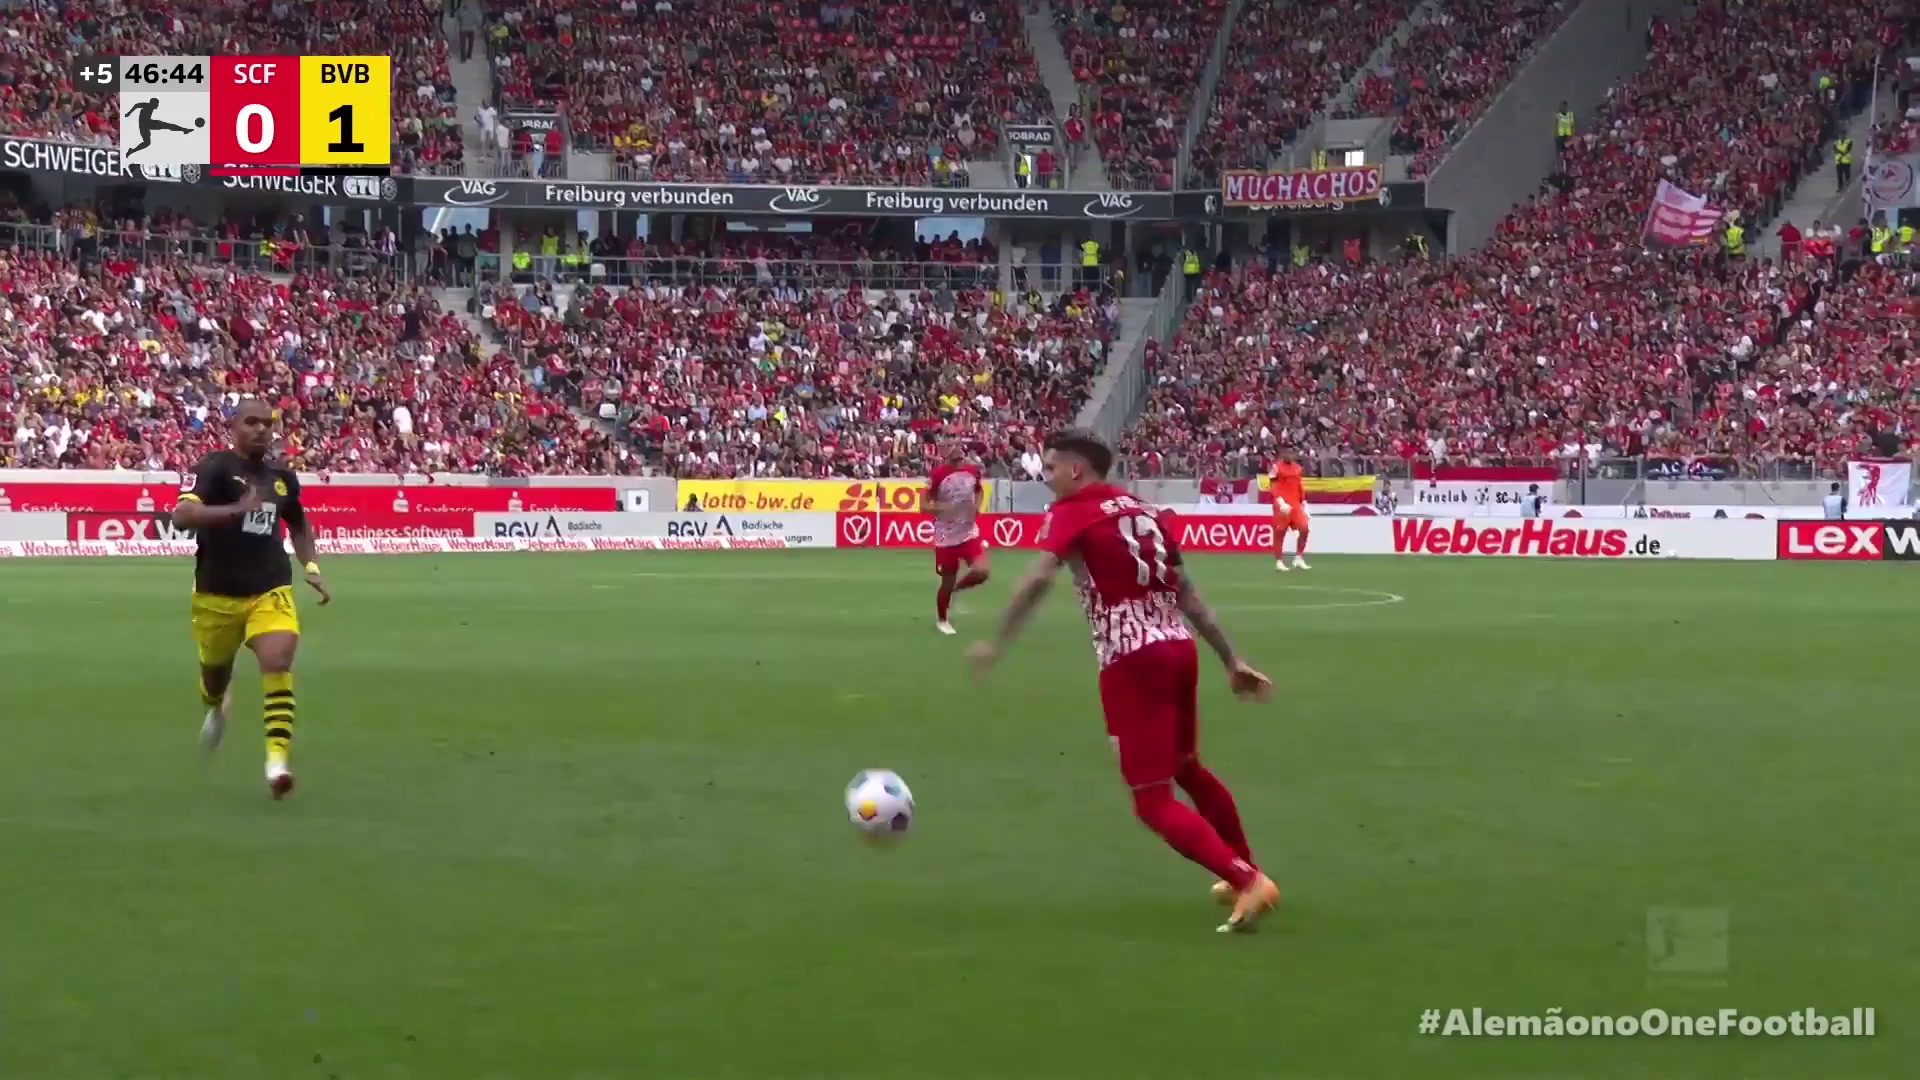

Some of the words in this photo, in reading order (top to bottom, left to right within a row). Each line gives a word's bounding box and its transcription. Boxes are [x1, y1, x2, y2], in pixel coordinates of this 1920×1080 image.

[460, 180, 497, 196] VAG
[1226, 169, 1378, 201] MUCHACHOS
[545, 185, 626, 207] Freiburg
[631, 187, 734, 206] verbunden
[786, 187, 820, 203] VAG
[866, 191, 944, 213] Freiburg
[949, 194, 1049, 212] verbunden
[1099, 194, 1133, 209] VAG
[702, 492, 815, 510] lotto-bw.de
